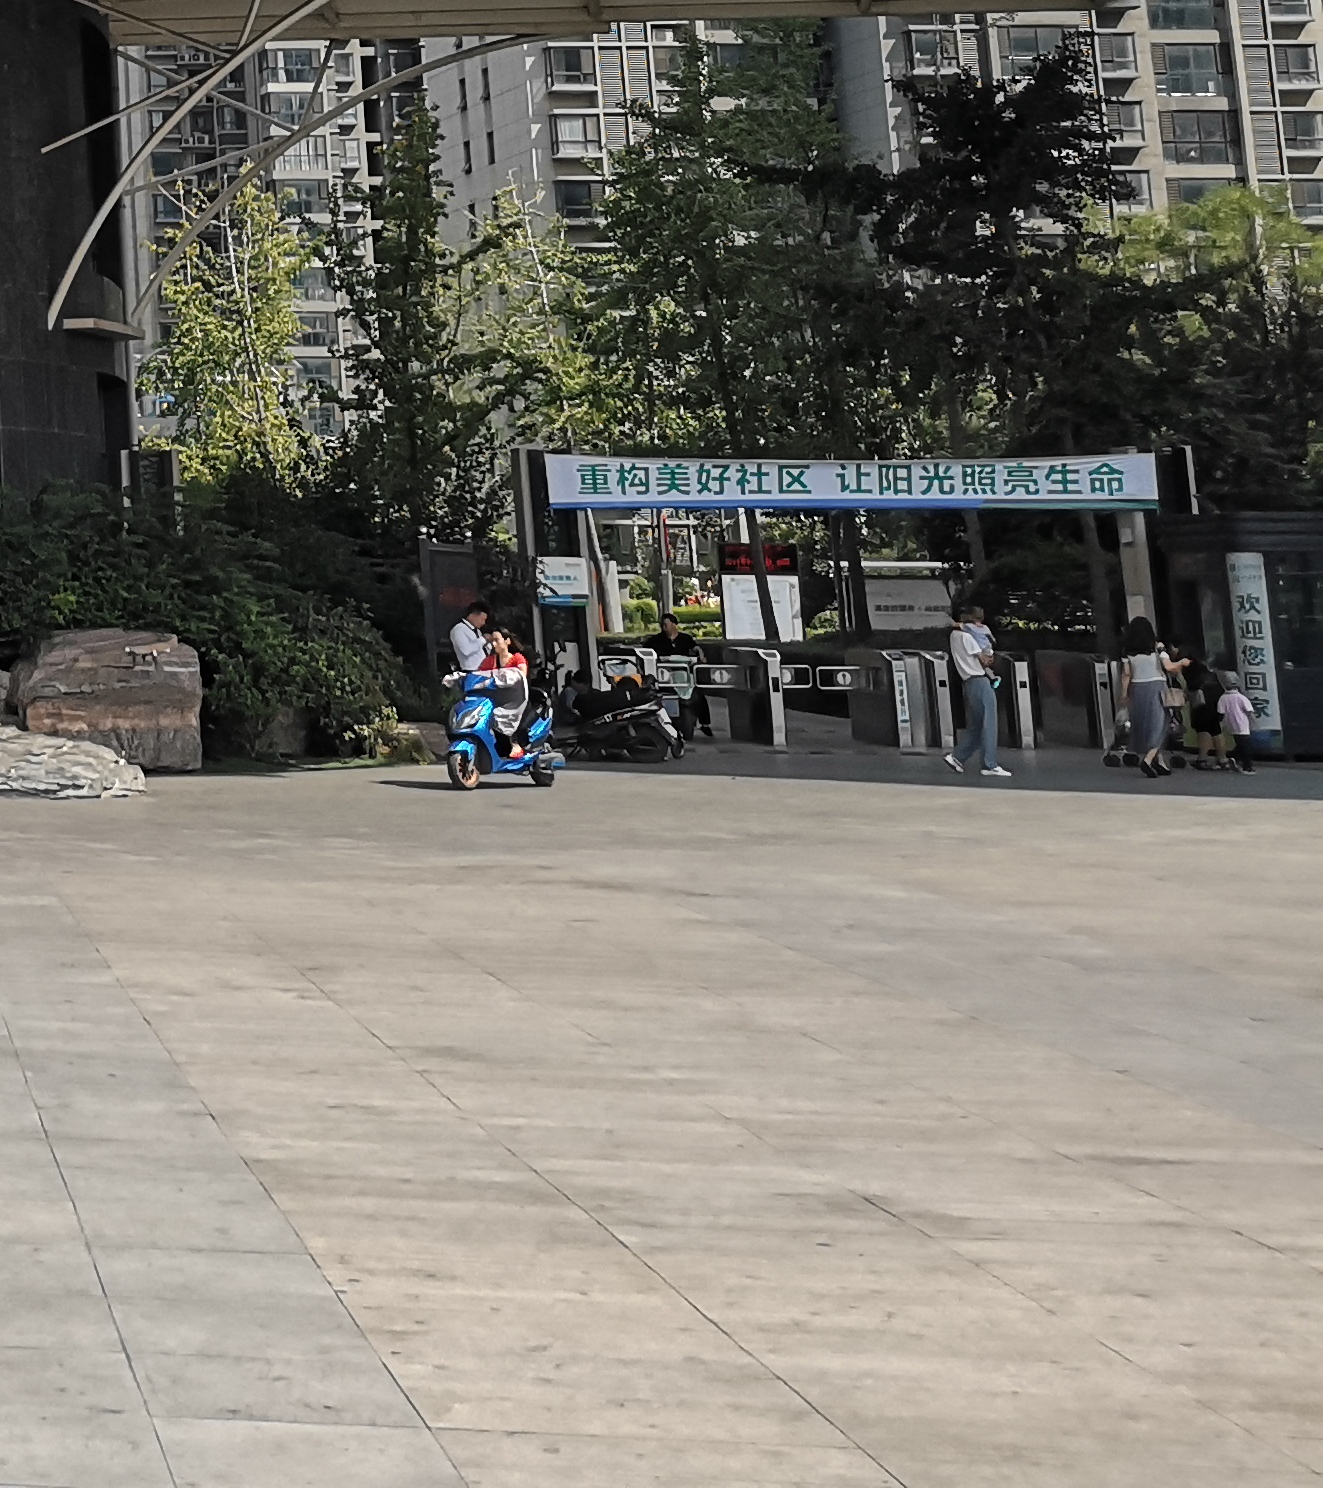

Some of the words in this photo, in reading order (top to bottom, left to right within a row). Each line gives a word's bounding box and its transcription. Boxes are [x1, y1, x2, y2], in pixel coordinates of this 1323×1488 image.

[576, 462, 812, 496] 重构美好社区
[835, 462, 1125, 497] 让阳光照亮生命
